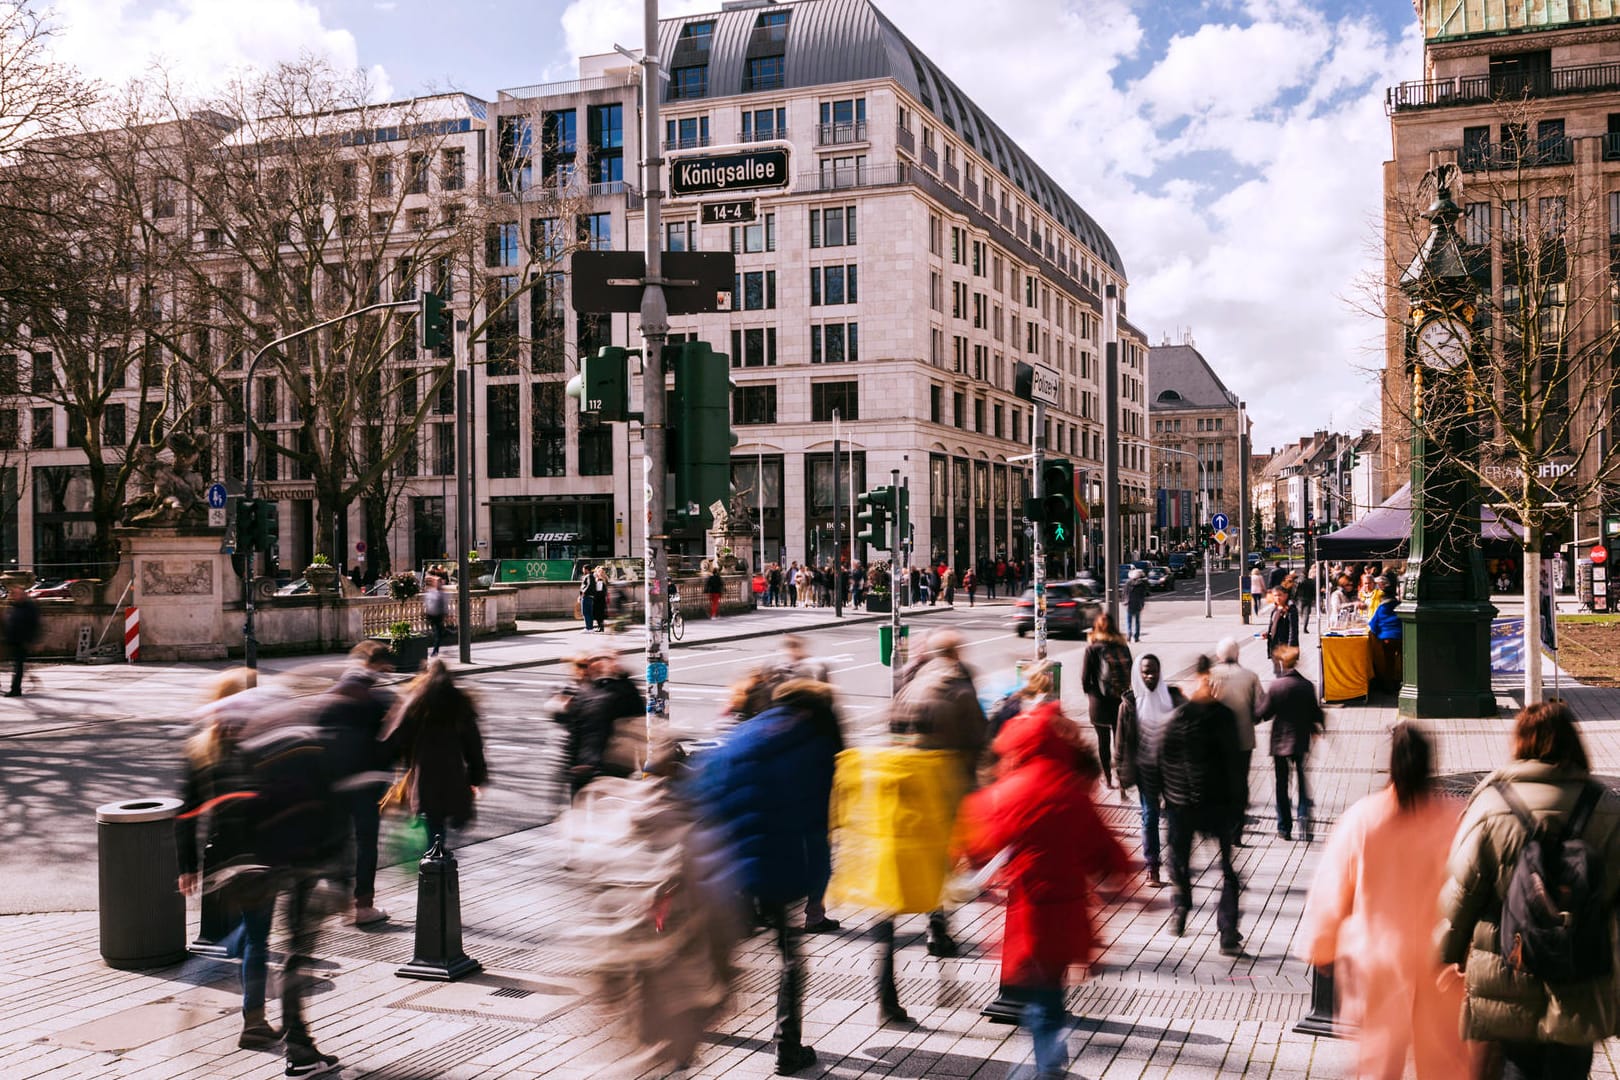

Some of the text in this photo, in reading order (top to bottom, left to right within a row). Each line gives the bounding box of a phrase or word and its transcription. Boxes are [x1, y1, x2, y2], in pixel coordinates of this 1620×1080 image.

[681, 158, 775, 188] Königsallee
[713, 204, 743, 220] 14-4
[1033, 371, 1053, 397] Polizei
[588, 400, 602, 410] 112
[826, 522, 846, 530] BOS
[526, 532, 579, 542] BOSE
